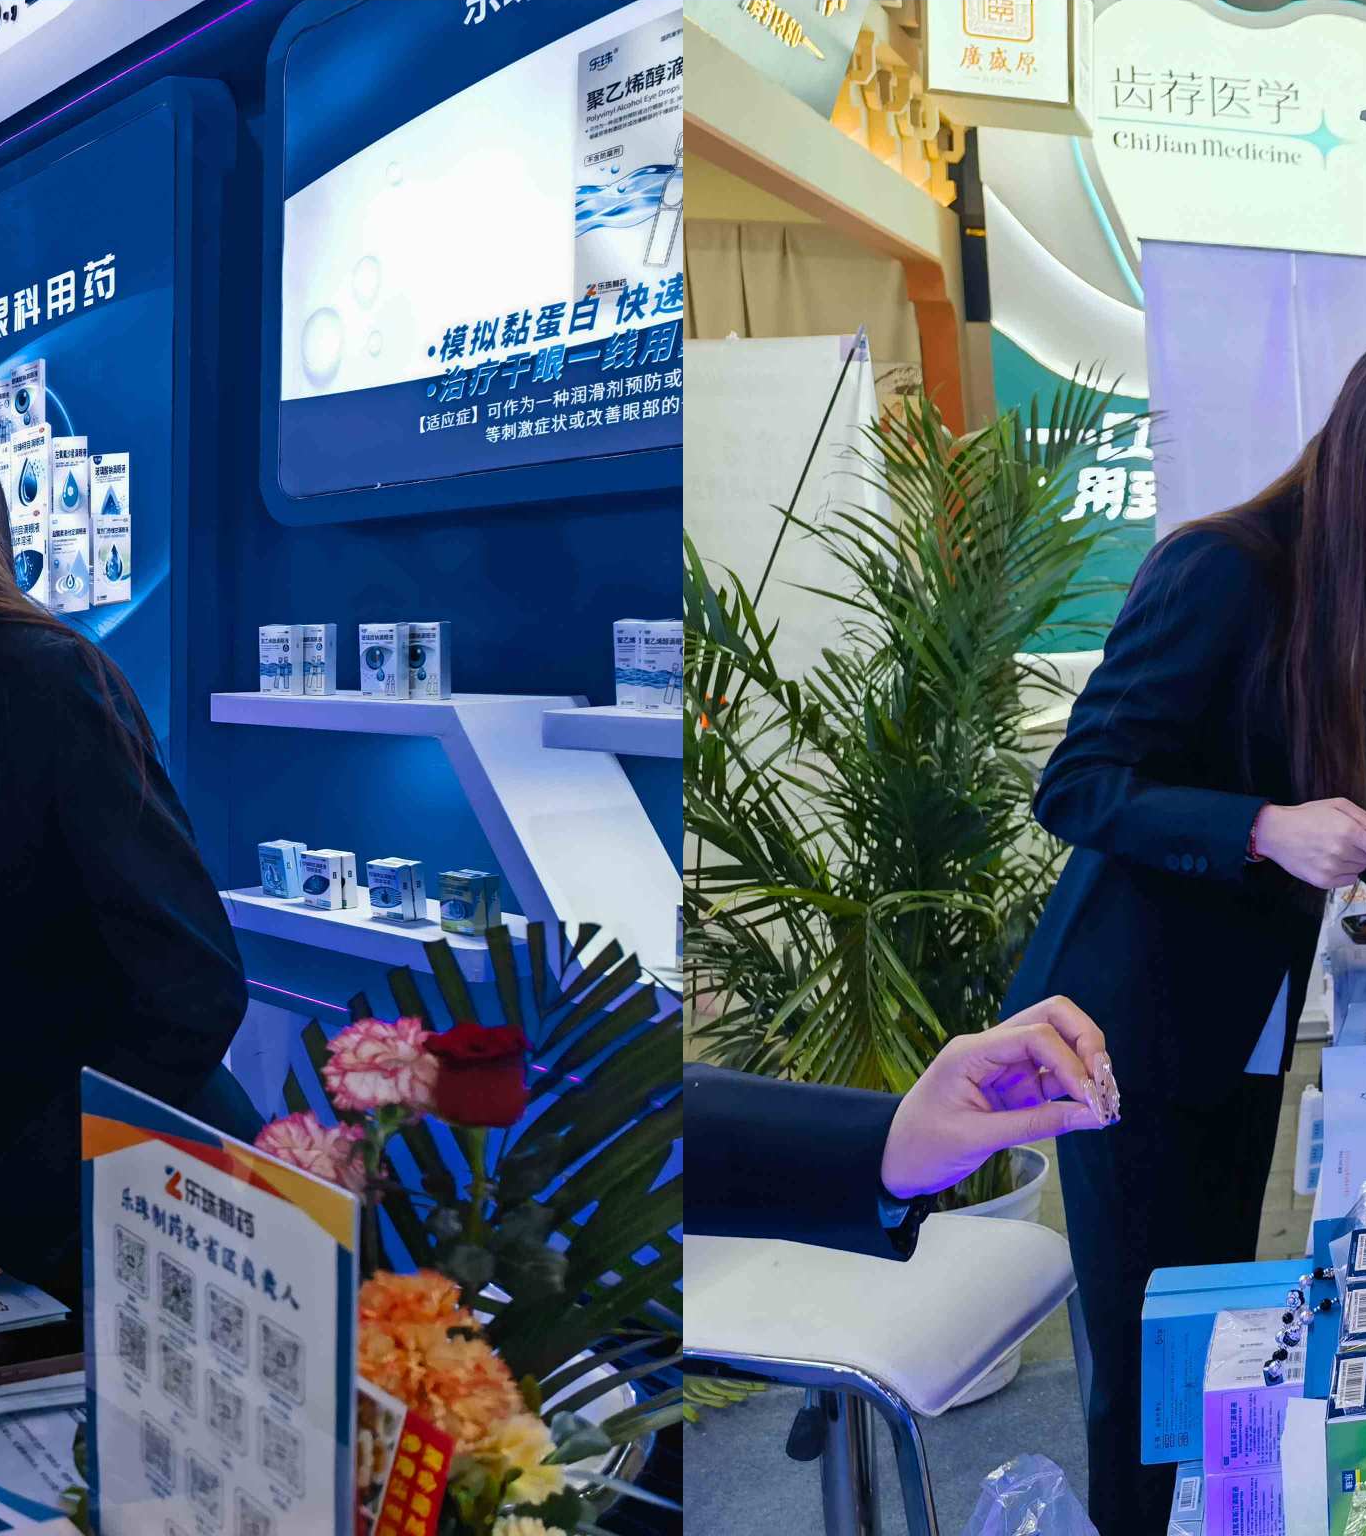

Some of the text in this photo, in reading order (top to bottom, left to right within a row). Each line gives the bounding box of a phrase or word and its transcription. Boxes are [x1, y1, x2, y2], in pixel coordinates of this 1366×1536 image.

[959, 44, 1037, 76] 廣盛原
[586, 106, 616, 124] Polyvinyl
[617, 96, 643, 114] Alcohol
[643, 91, 657, 103] Eye
[1111, 65, 1303, 128] 齿荐医学
[587, 146, 621, 163] 不含防腐剂
[1111, 129, 1303, 167] ChiJian Medicine
[439, 295, 602, 363] 模拟黏蛋白
[439, 323, 683, 403] 治疗干眼一线用
[487, 367, 683, 420] 可作为一种润滑剂预防或
[184, 1178, 257, 1239] 乐珠制药
